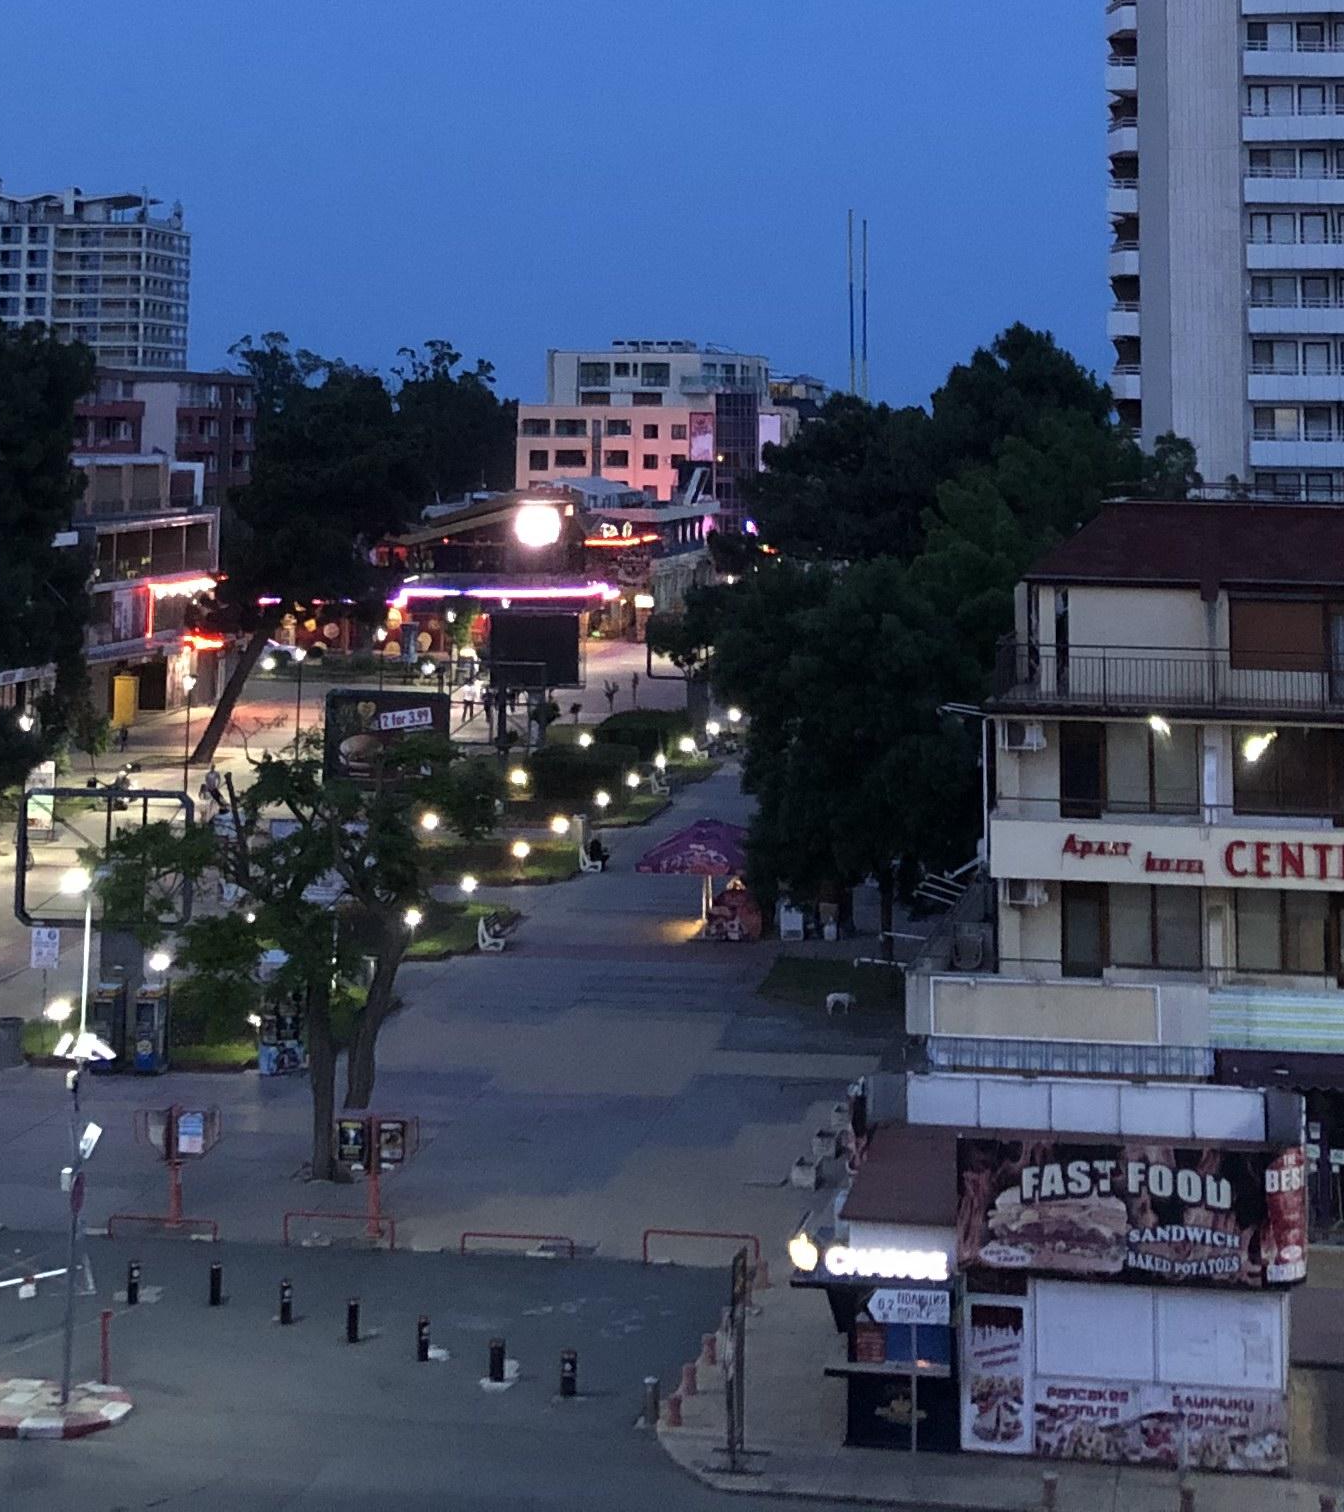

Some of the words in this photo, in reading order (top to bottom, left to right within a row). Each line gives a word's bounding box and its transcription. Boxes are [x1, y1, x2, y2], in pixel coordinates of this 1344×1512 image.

[1021, 1159, 1117, 1200] FAST
[1127, 1160, 1233, 1210] FOOD
[1128, 1224, 1241, 1249] SANDWICH
[1127, 1250, 1172, 1273] BAKED
[1174, 1254, 1241, 1277] POTATOES
